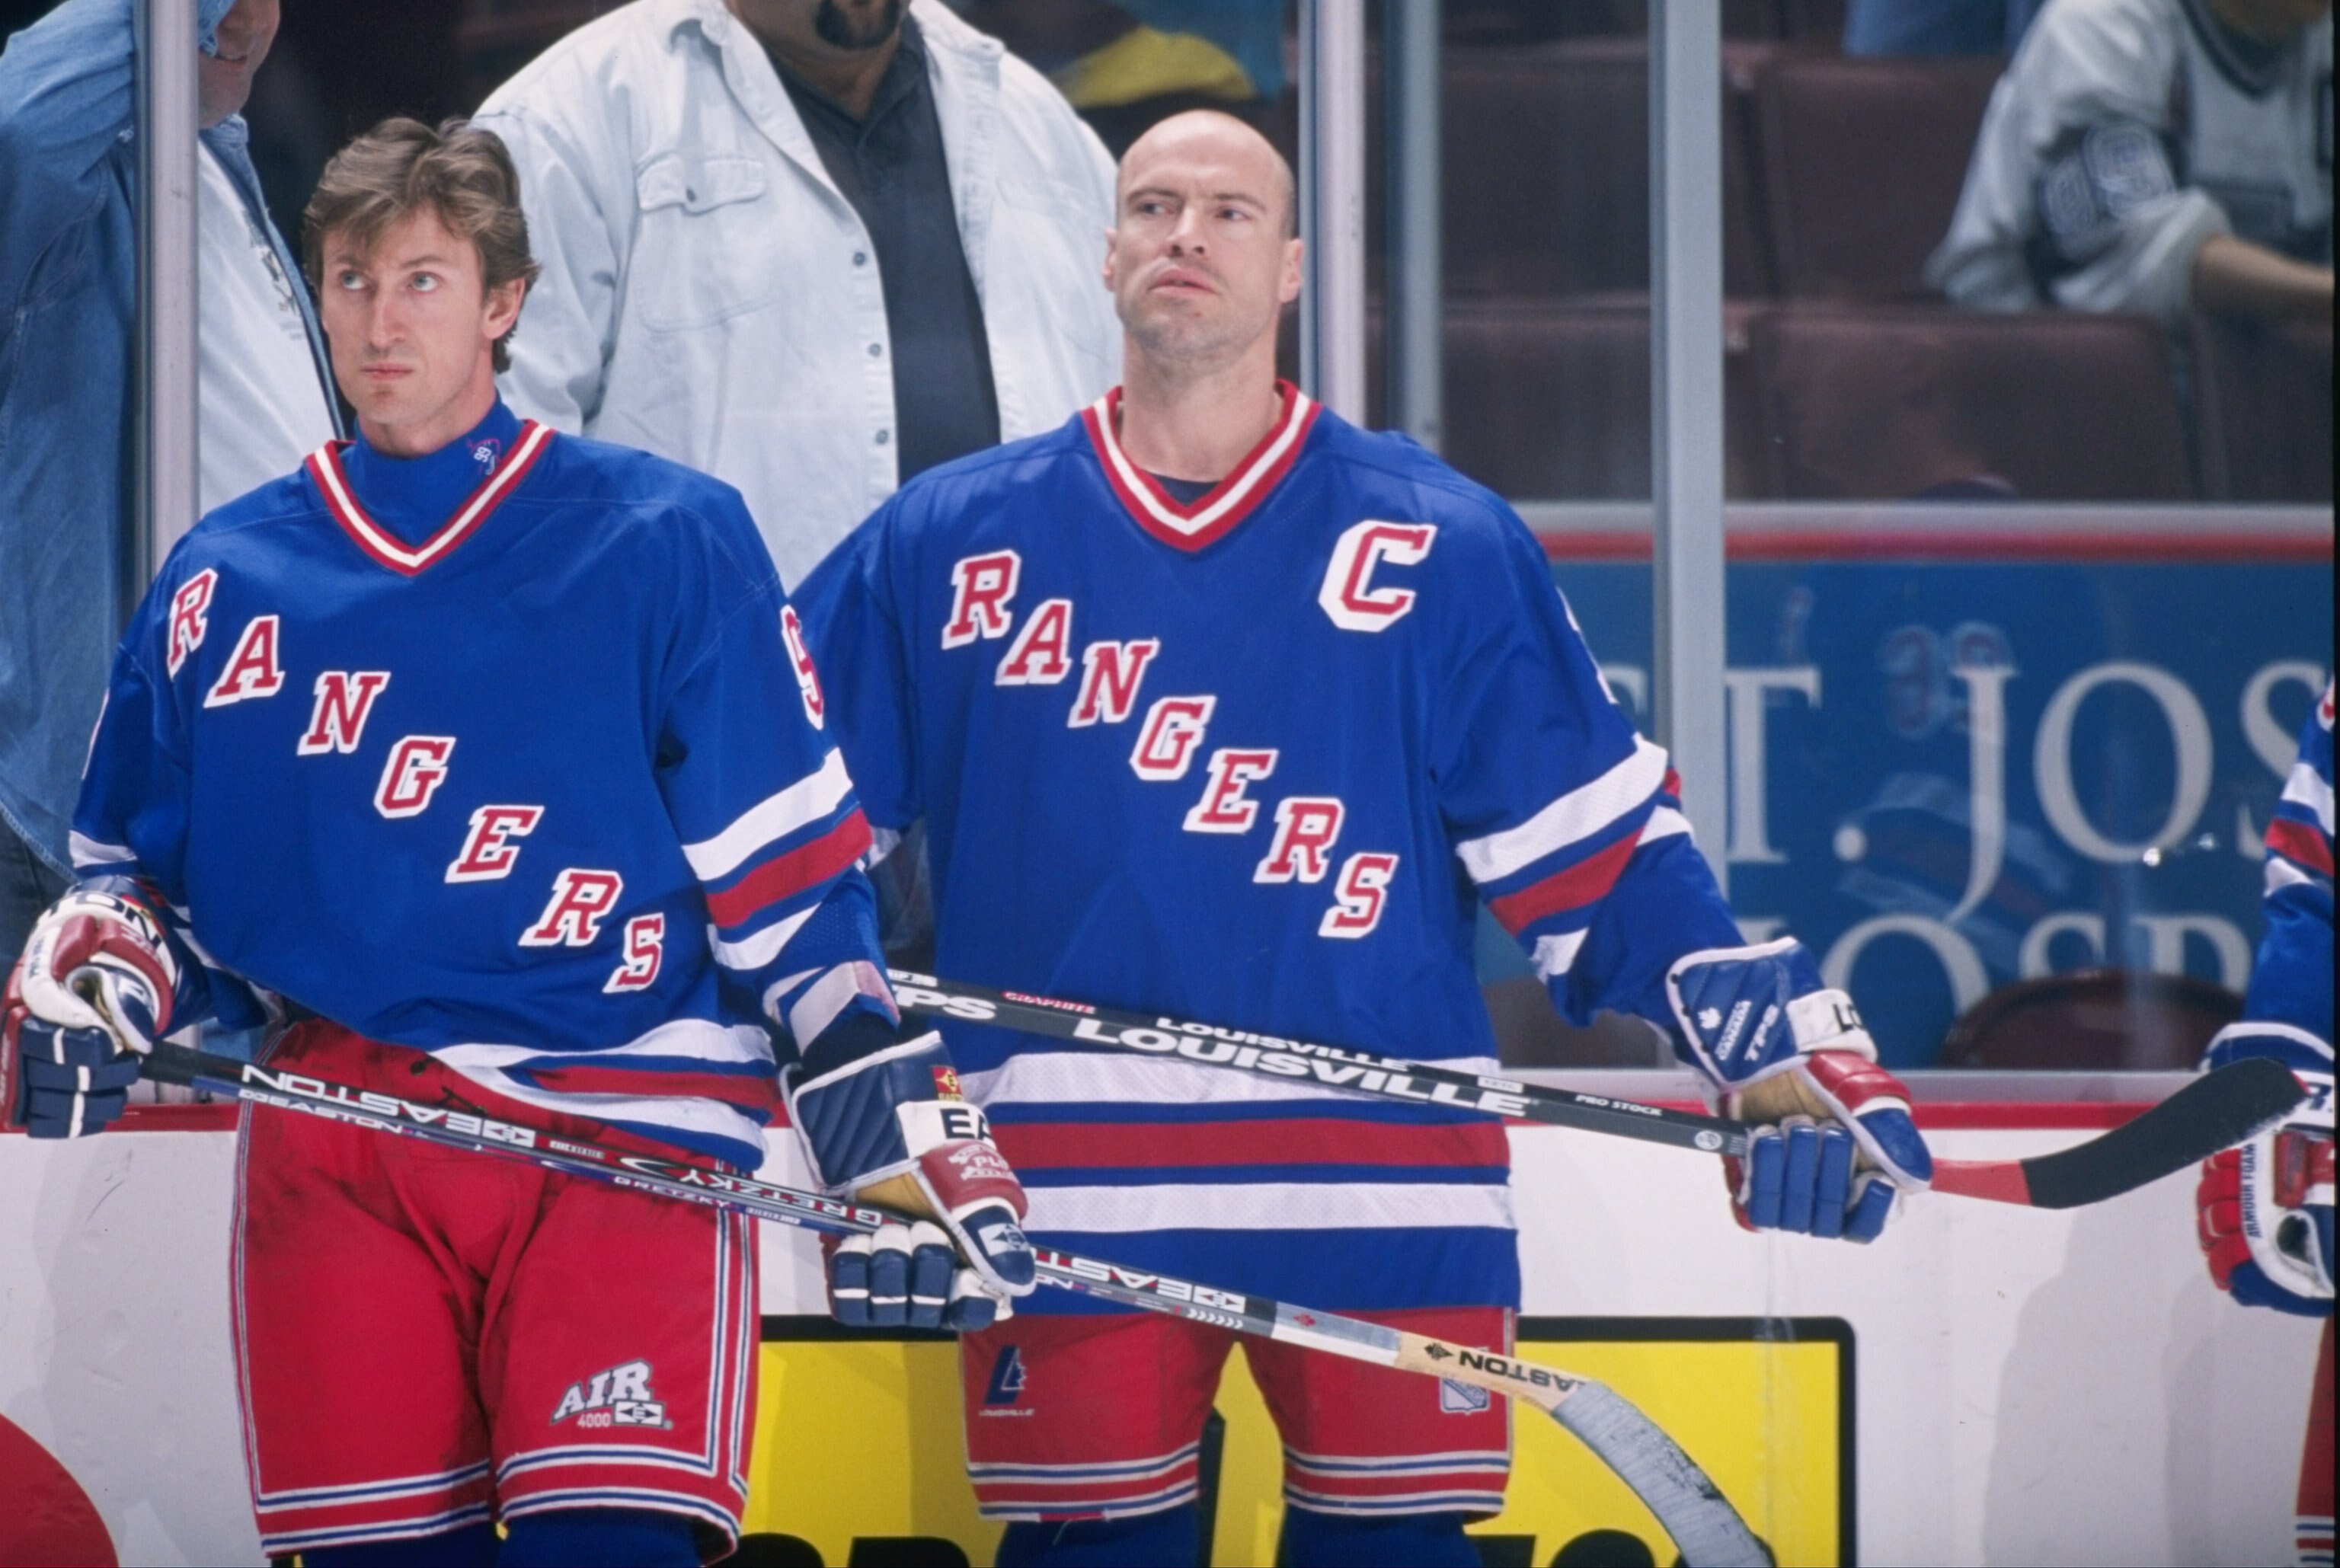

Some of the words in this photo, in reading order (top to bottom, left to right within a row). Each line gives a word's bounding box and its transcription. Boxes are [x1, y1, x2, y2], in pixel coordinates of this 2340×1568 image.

[474, 446, 492, 463] 99
[1319, 519, 1438, 633] C
[941, 548, 1399, 938] RANGERS
[167, 567, 664, 993] RANGERS
[891, 985, 997, 1020] PS
[1073, 1018, 1531, 1117] LOUISVILLE
[1156, 1017, 1409, 1071] LOUISVILLE
[241, 1064, 483, 1136] EASTON
[268, 1094, 404, 1134] EASTON
[1574, 1094, 1610, 1106] PRO
[1611, 1099, 1662, 1116] STOCK
[2242, 1143, 2256, 1180] FOAM
[612, 1176, 734, 1209] GRETZKY
[679, 1168, 882, 1227] GRETZKY
[2242, 1184, 2262, 1238] ARMOUR
[551, 1359, 654, 1424] AIR
[1459, 1350, 1587, 1393] ASTON
[577, 1413, 612, 1428] 4000
